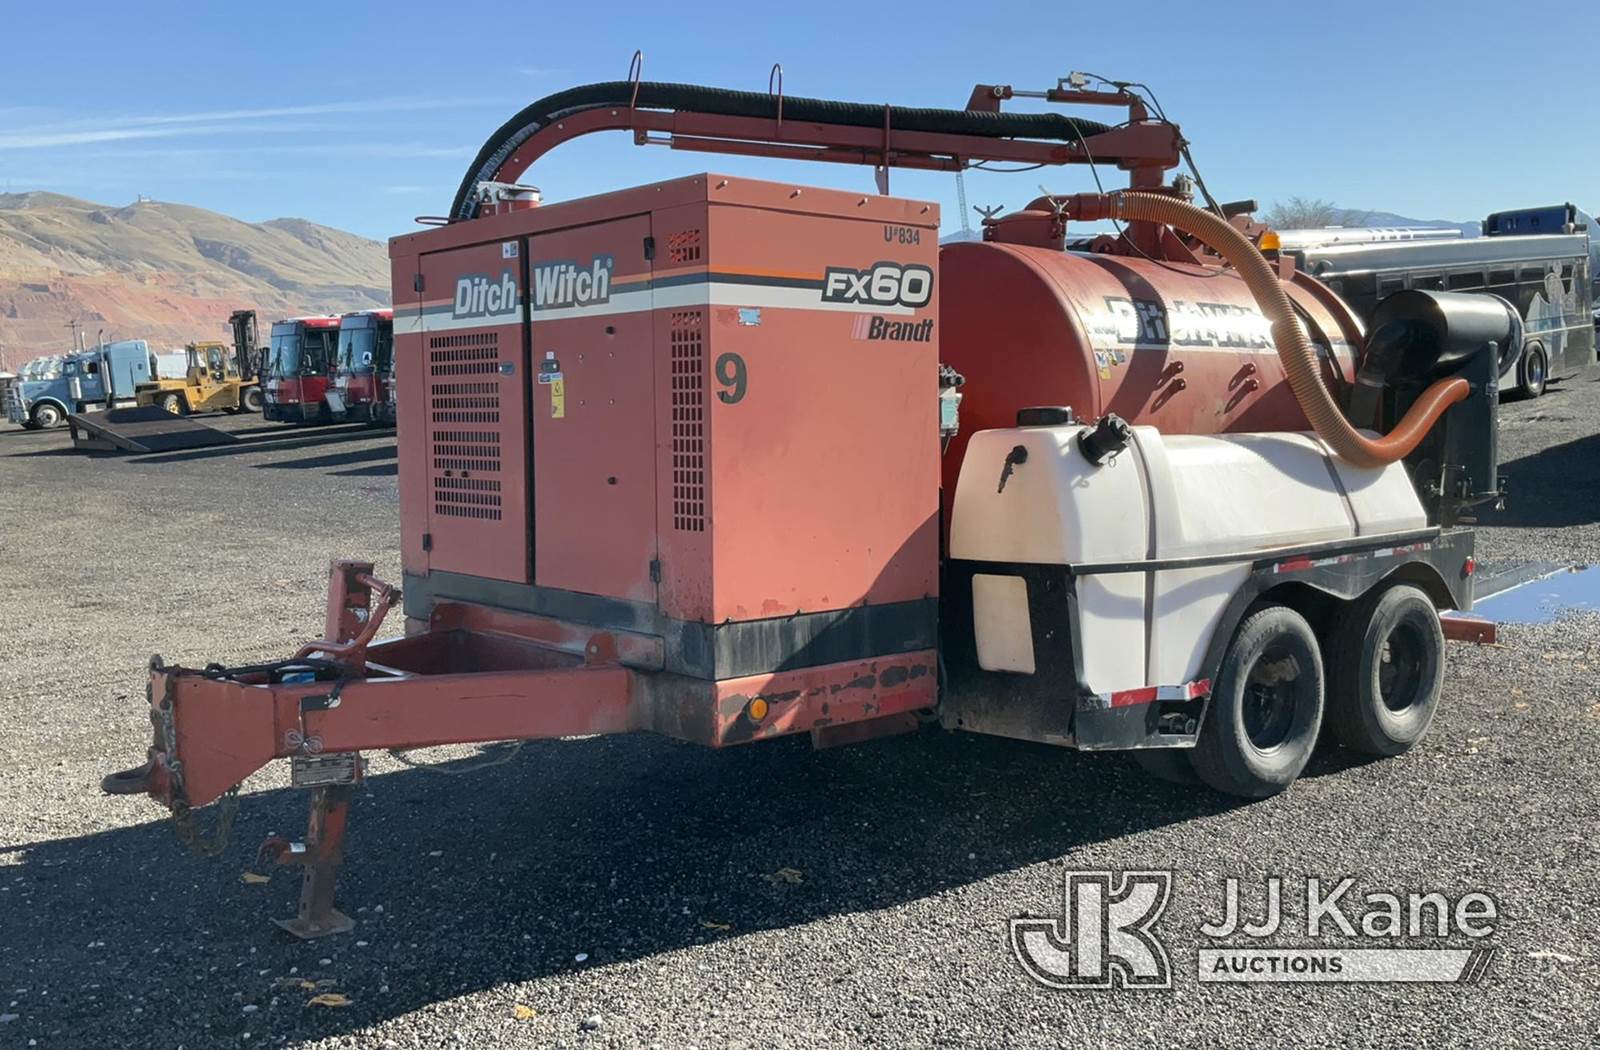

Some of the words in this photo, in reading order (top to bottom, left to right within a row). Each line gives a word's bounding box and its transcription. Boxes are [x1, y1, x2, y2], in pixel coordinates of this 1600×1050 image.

[454, 272, 517, 316] Ditch
[825, 266, 932, 304] FX60
[867, 315, 934, 343] Brandt
[714, 352, 747, 405] 9
